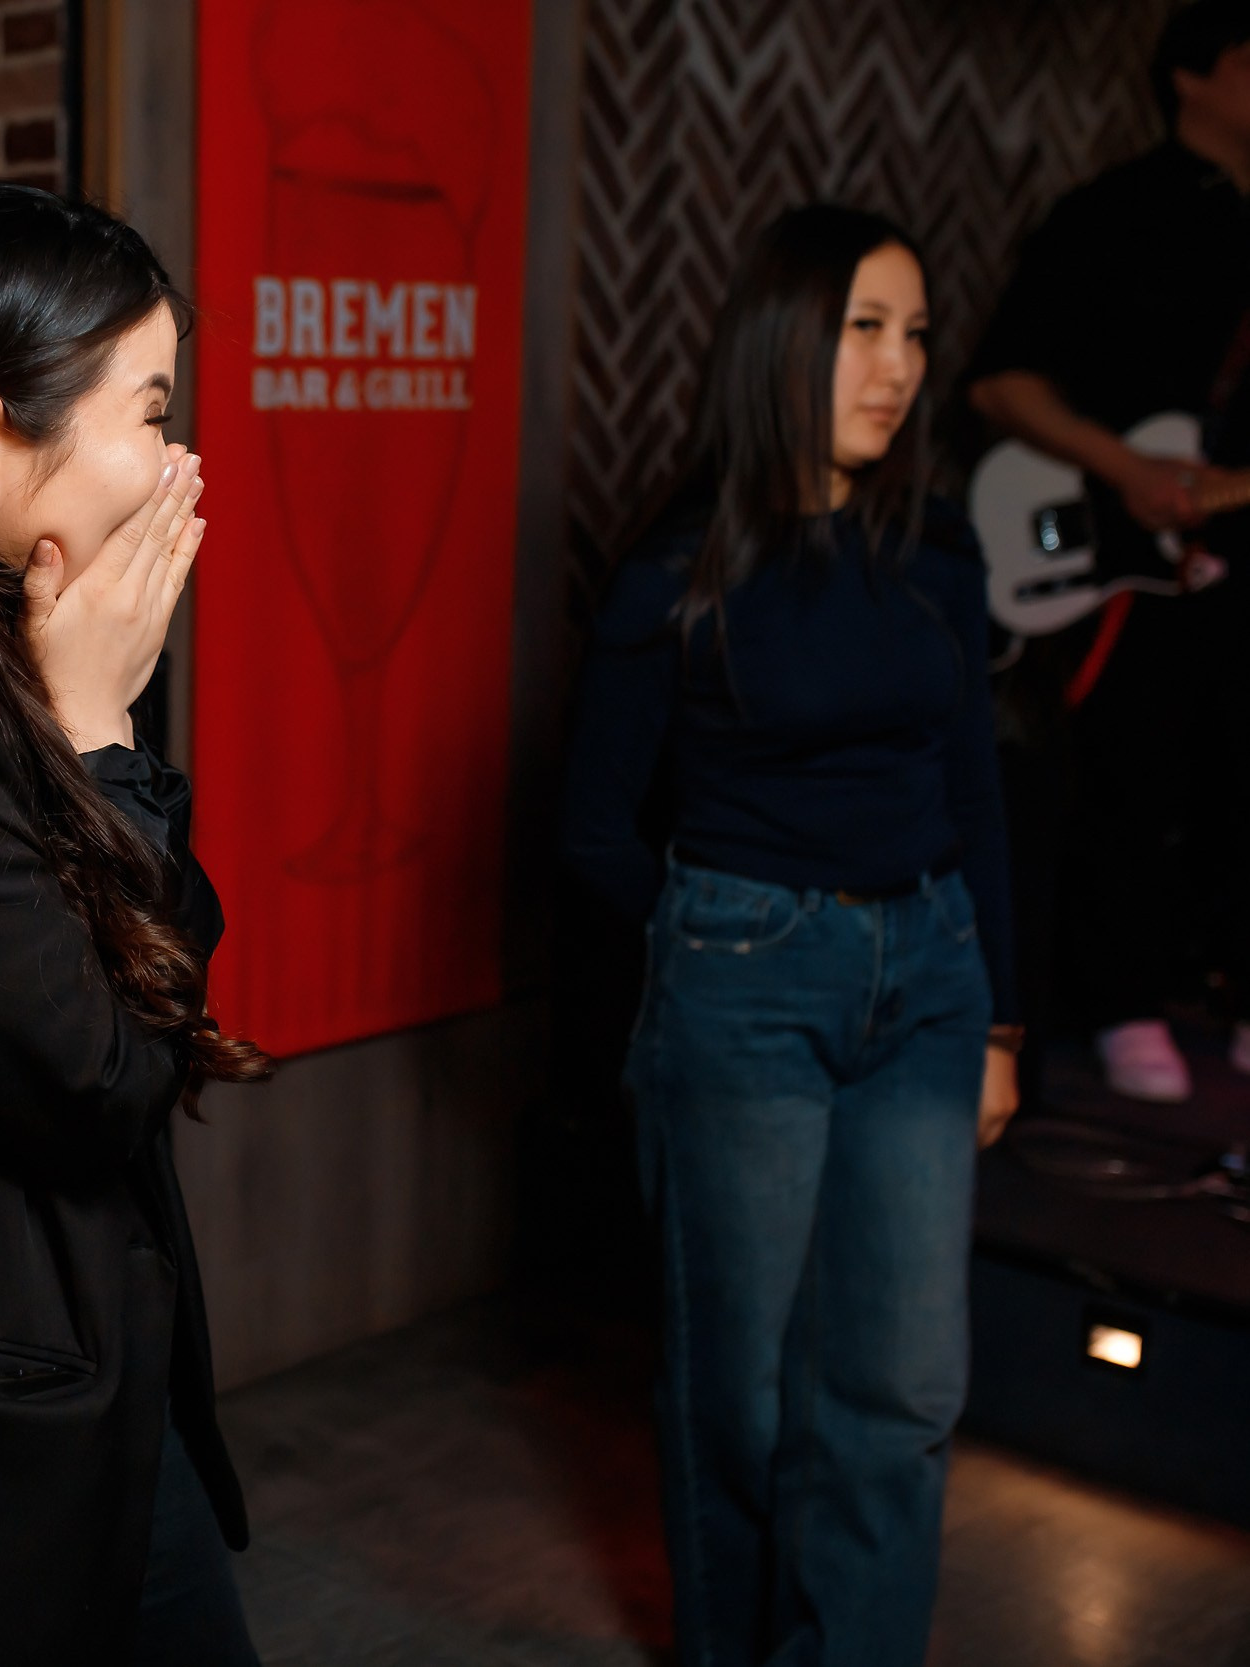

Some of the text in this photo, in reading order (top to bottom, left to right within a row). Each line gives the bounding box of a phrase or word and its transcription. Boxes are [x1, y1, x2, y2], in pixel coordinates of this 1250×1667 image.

[254, 277, 477, 358] BREMEN
[253, 367, 472, 409] BAR & GRILL
